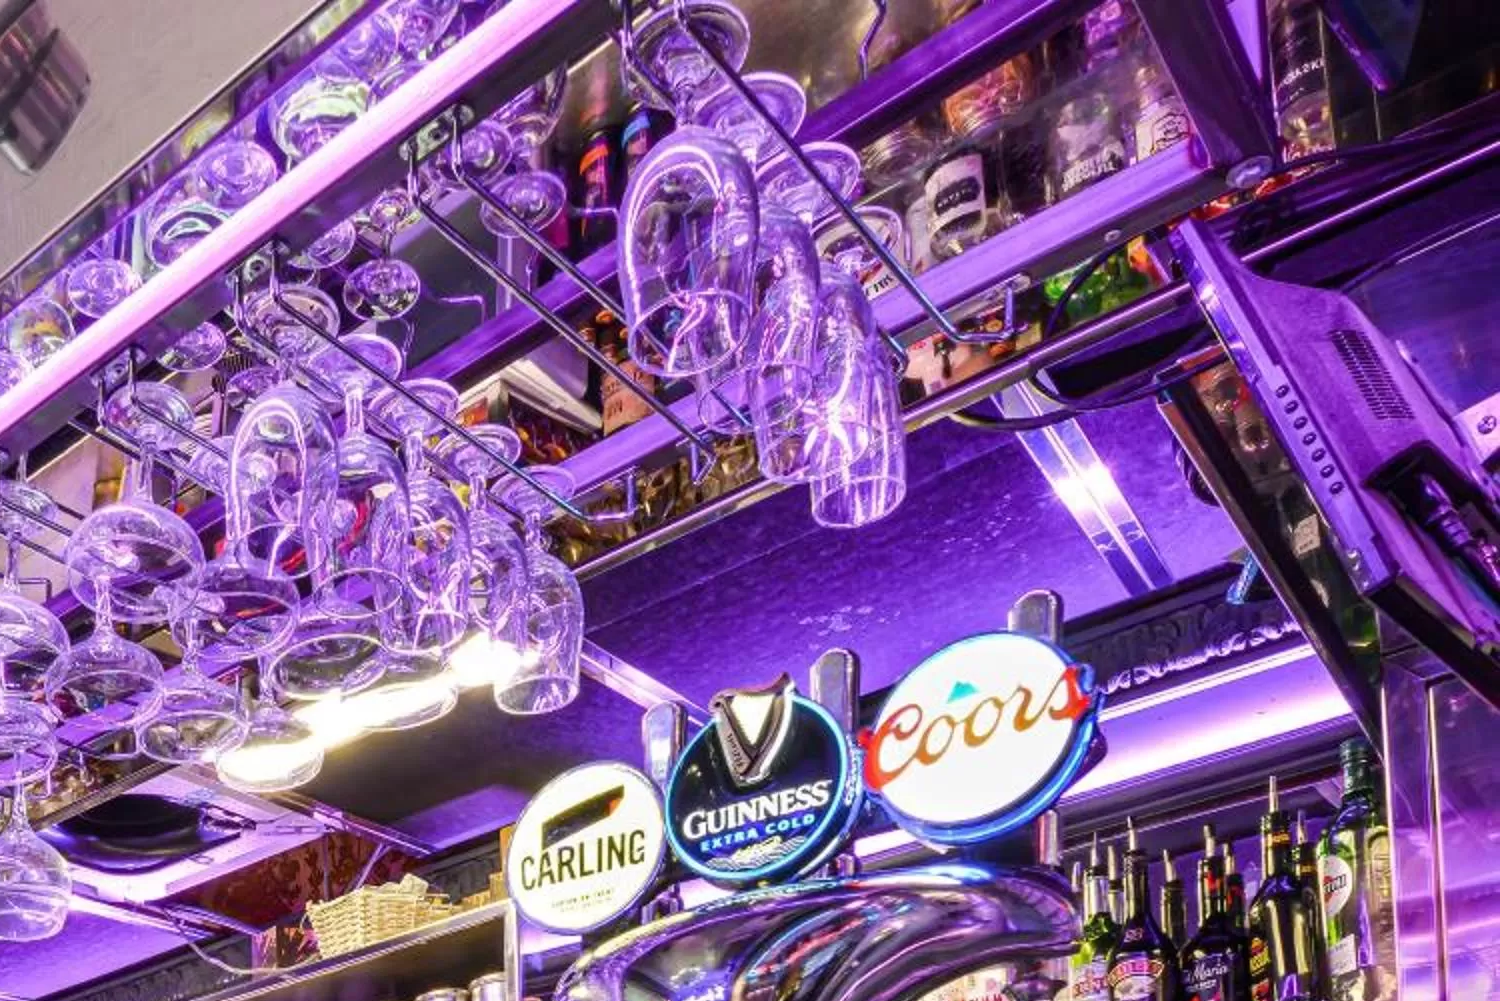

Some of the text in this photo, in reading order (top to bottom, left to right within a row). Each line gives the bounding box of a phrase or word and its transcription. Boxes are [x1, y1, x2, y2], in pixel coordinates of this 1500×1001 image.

[857, 665, 1090, 790] Coors
[682, 780, 833, 839] GUINNESS
[700, 813, 816, 852] EXTRA COLD
[521, 829, 645, 891] CARLING
